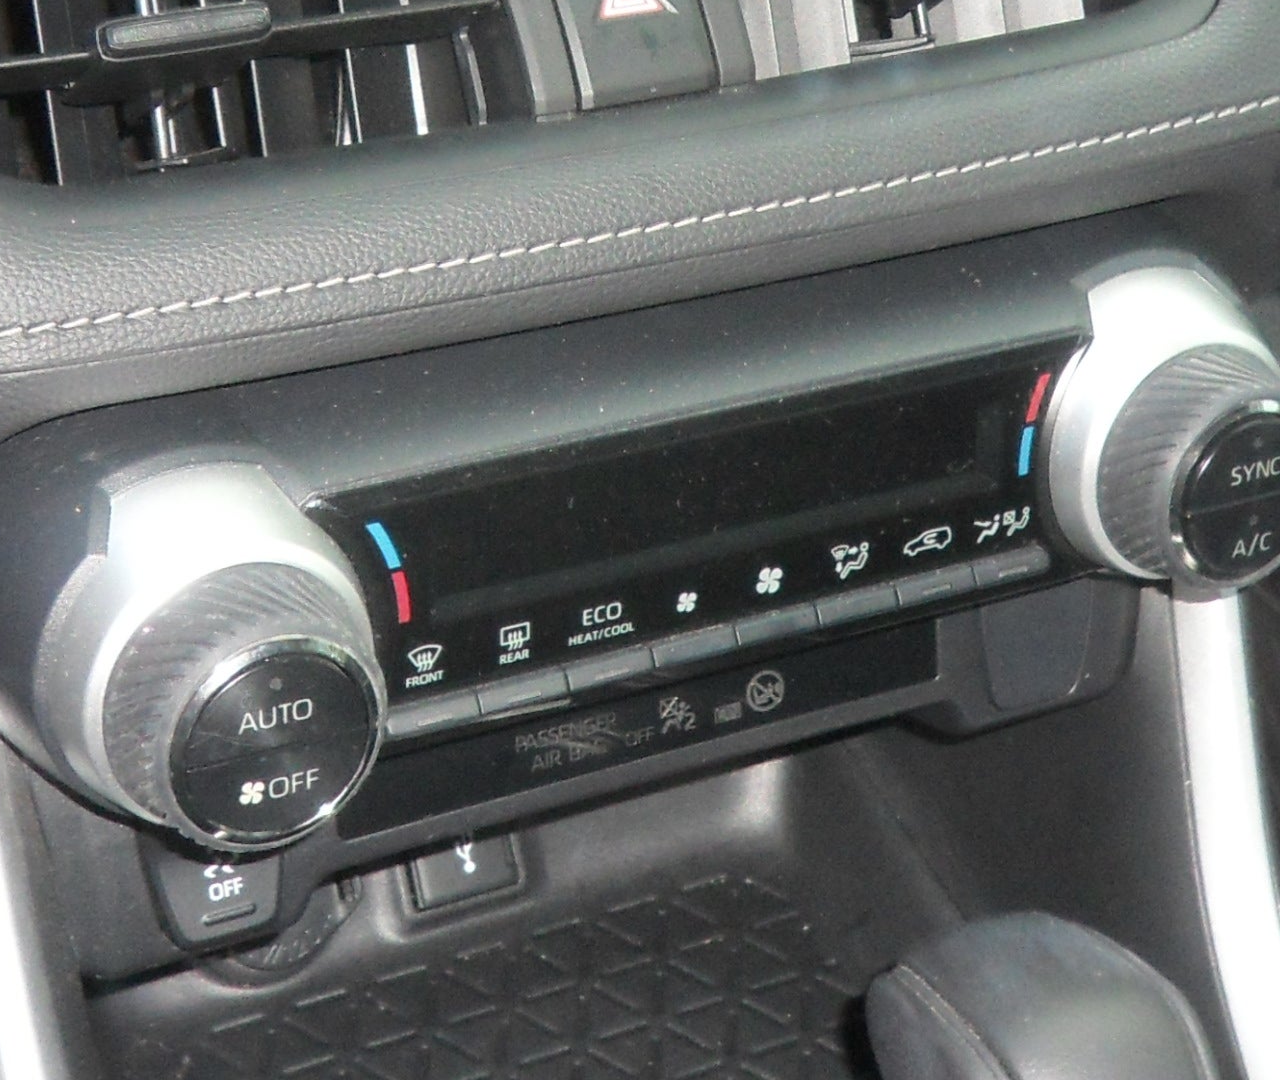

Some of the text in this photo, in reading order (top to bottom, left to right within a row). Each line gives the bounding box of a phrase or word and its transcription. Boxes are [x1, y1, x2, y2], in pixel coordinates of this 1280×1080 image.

[1231, 532, 1272, 559] A/C
[582, 601, 622, 627] ECO
[567, 621, 635, 647] HEAT/COOL
[499, 649, 530, 665] REAR
[405, 669, 445, 689] FRONT
[237, 698, 314, 736] AUTO
[514, 711, 619, 753] PASSENGER
[625, 725, 656, 748] OFF
[531, 750, 563, 773] AIR
[268, 768, 320, 800] OFF
[208, 877, 244, 902] OFF
